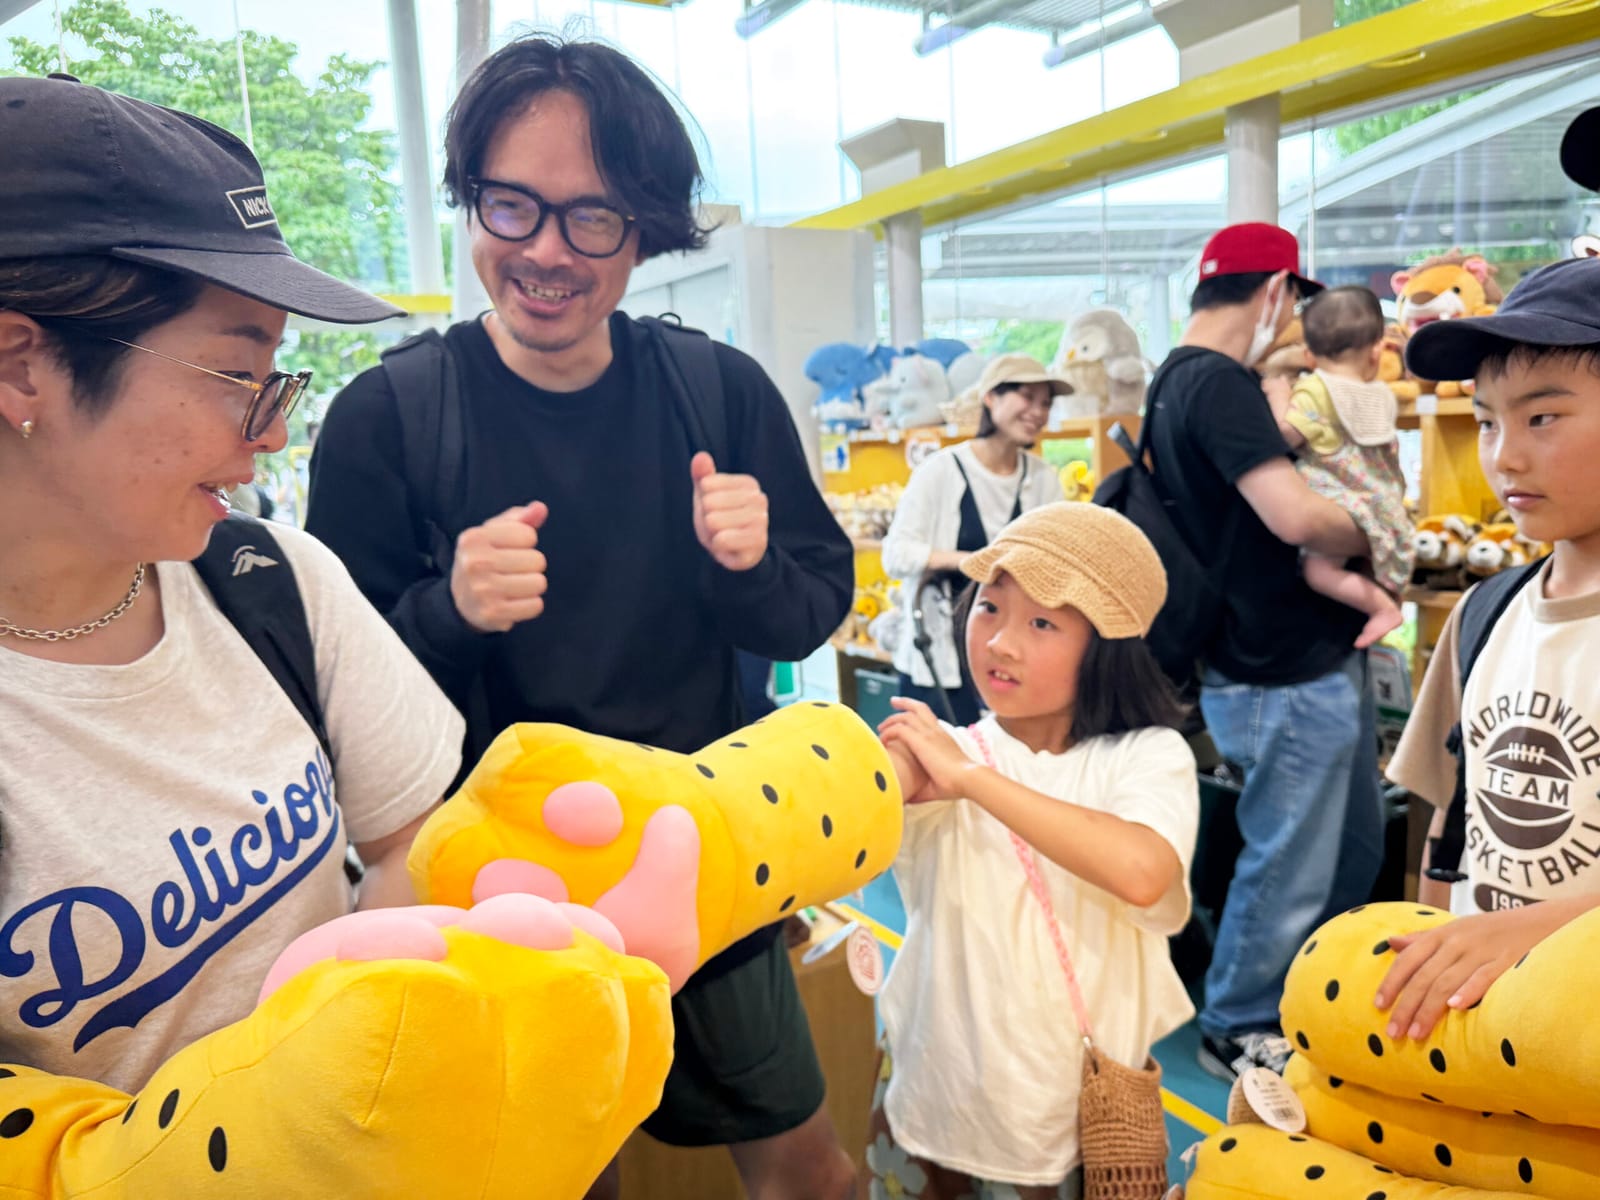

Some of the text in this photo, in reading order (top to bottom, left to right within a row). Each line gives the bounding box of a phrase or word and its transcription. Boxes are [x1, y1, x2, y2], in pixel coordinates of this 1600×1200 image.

[242, 195, 270, 217] NICK
[1468, 690, 1600, 777] WORLDWIDE
[1486, 766, 1569, 807] TEAM
[0, 744, 334, 1028] Deliciou
[1465, 812, 1600, 888] SKETBAL
